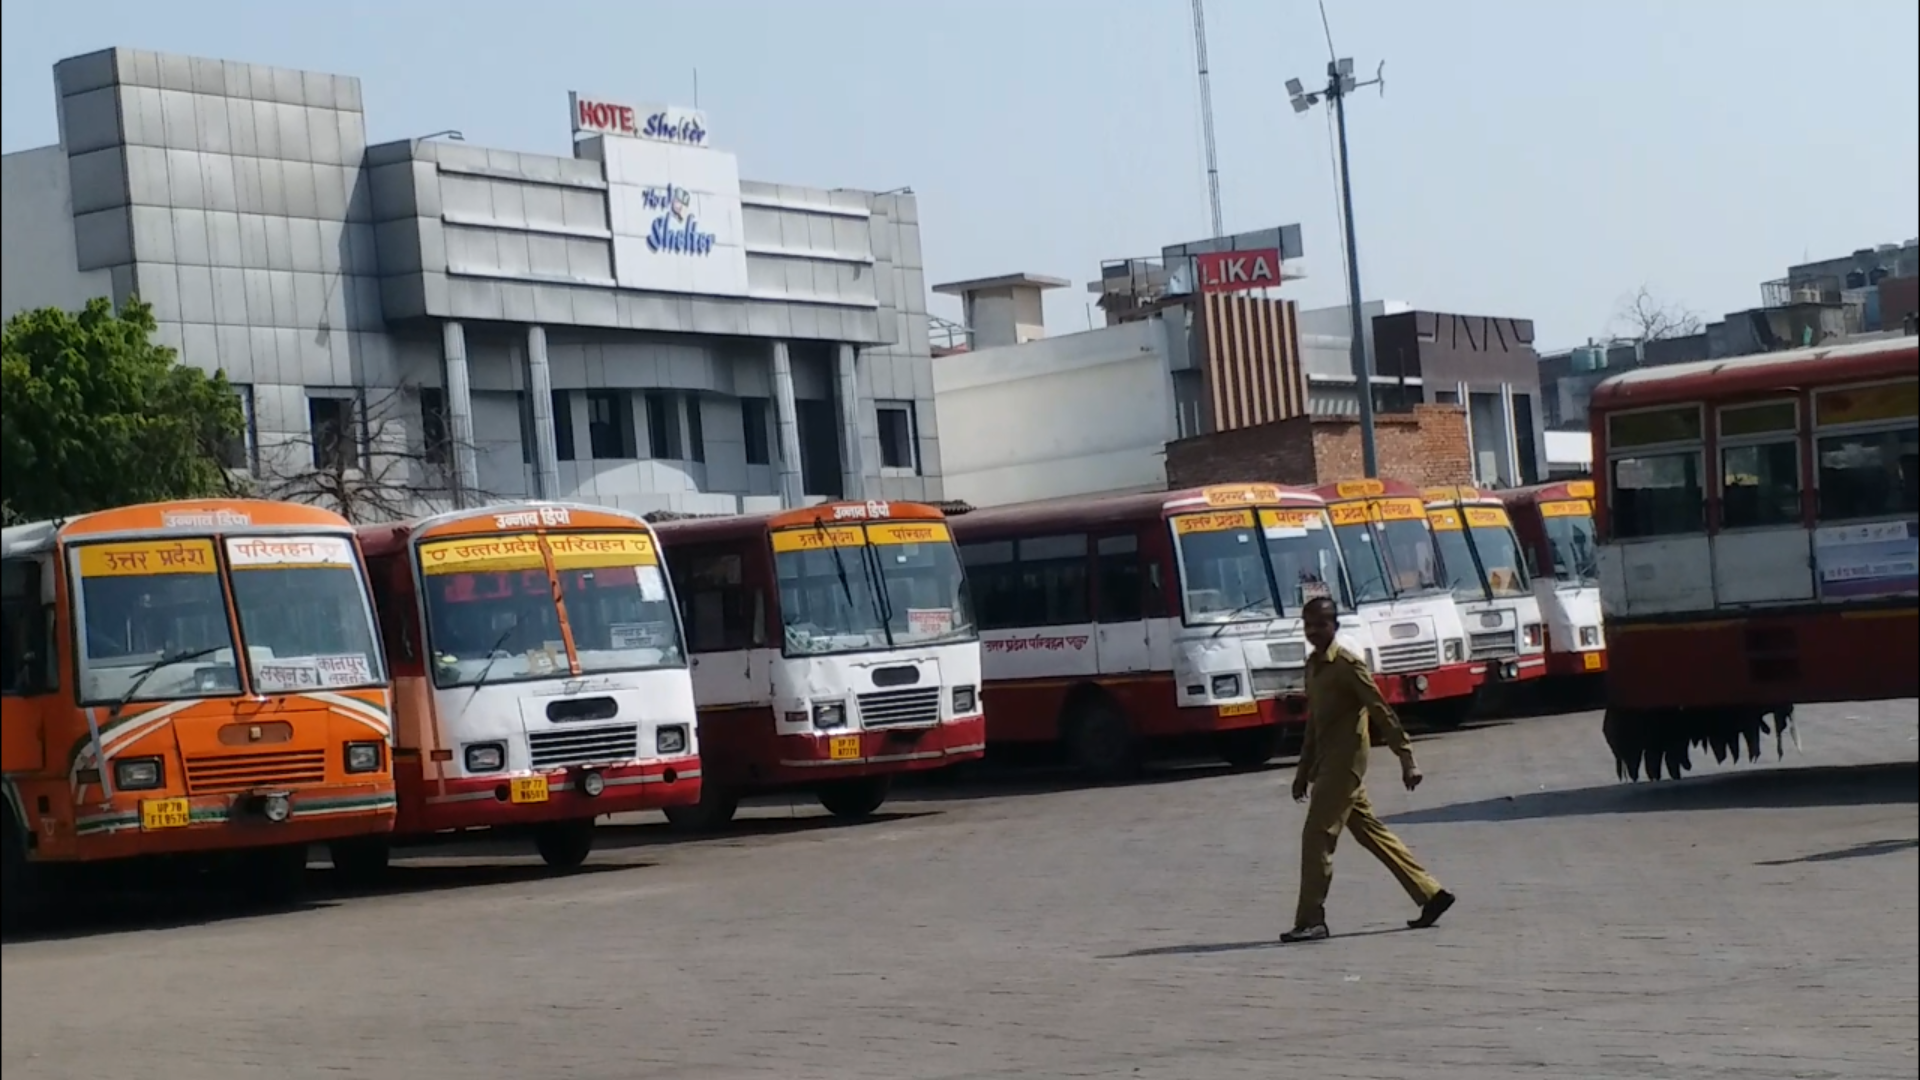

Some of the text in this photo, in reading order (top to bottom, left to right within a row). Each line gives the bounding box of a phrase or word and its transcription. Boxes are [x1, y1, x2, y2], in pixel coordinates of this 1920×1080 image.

[643, 112, 706, 143] Shelter
[646, 211, 716, 257] Shelter
[1202, 256, 1273, 285] LIKA
[493, 506, 572, 529] उन्नाव डिपो
[866, 500, 890, 518] डिपो
[104, 543, 206, 571] उत्तर प्रदेश
[234, 539, 315, 559] परिवहन
[456, 536, 627, 560] उत्तर प्रदेश परिवहन
[260, 666, 315, 685] लखनऊ
[316, 656, 367, 675] कानपुर
